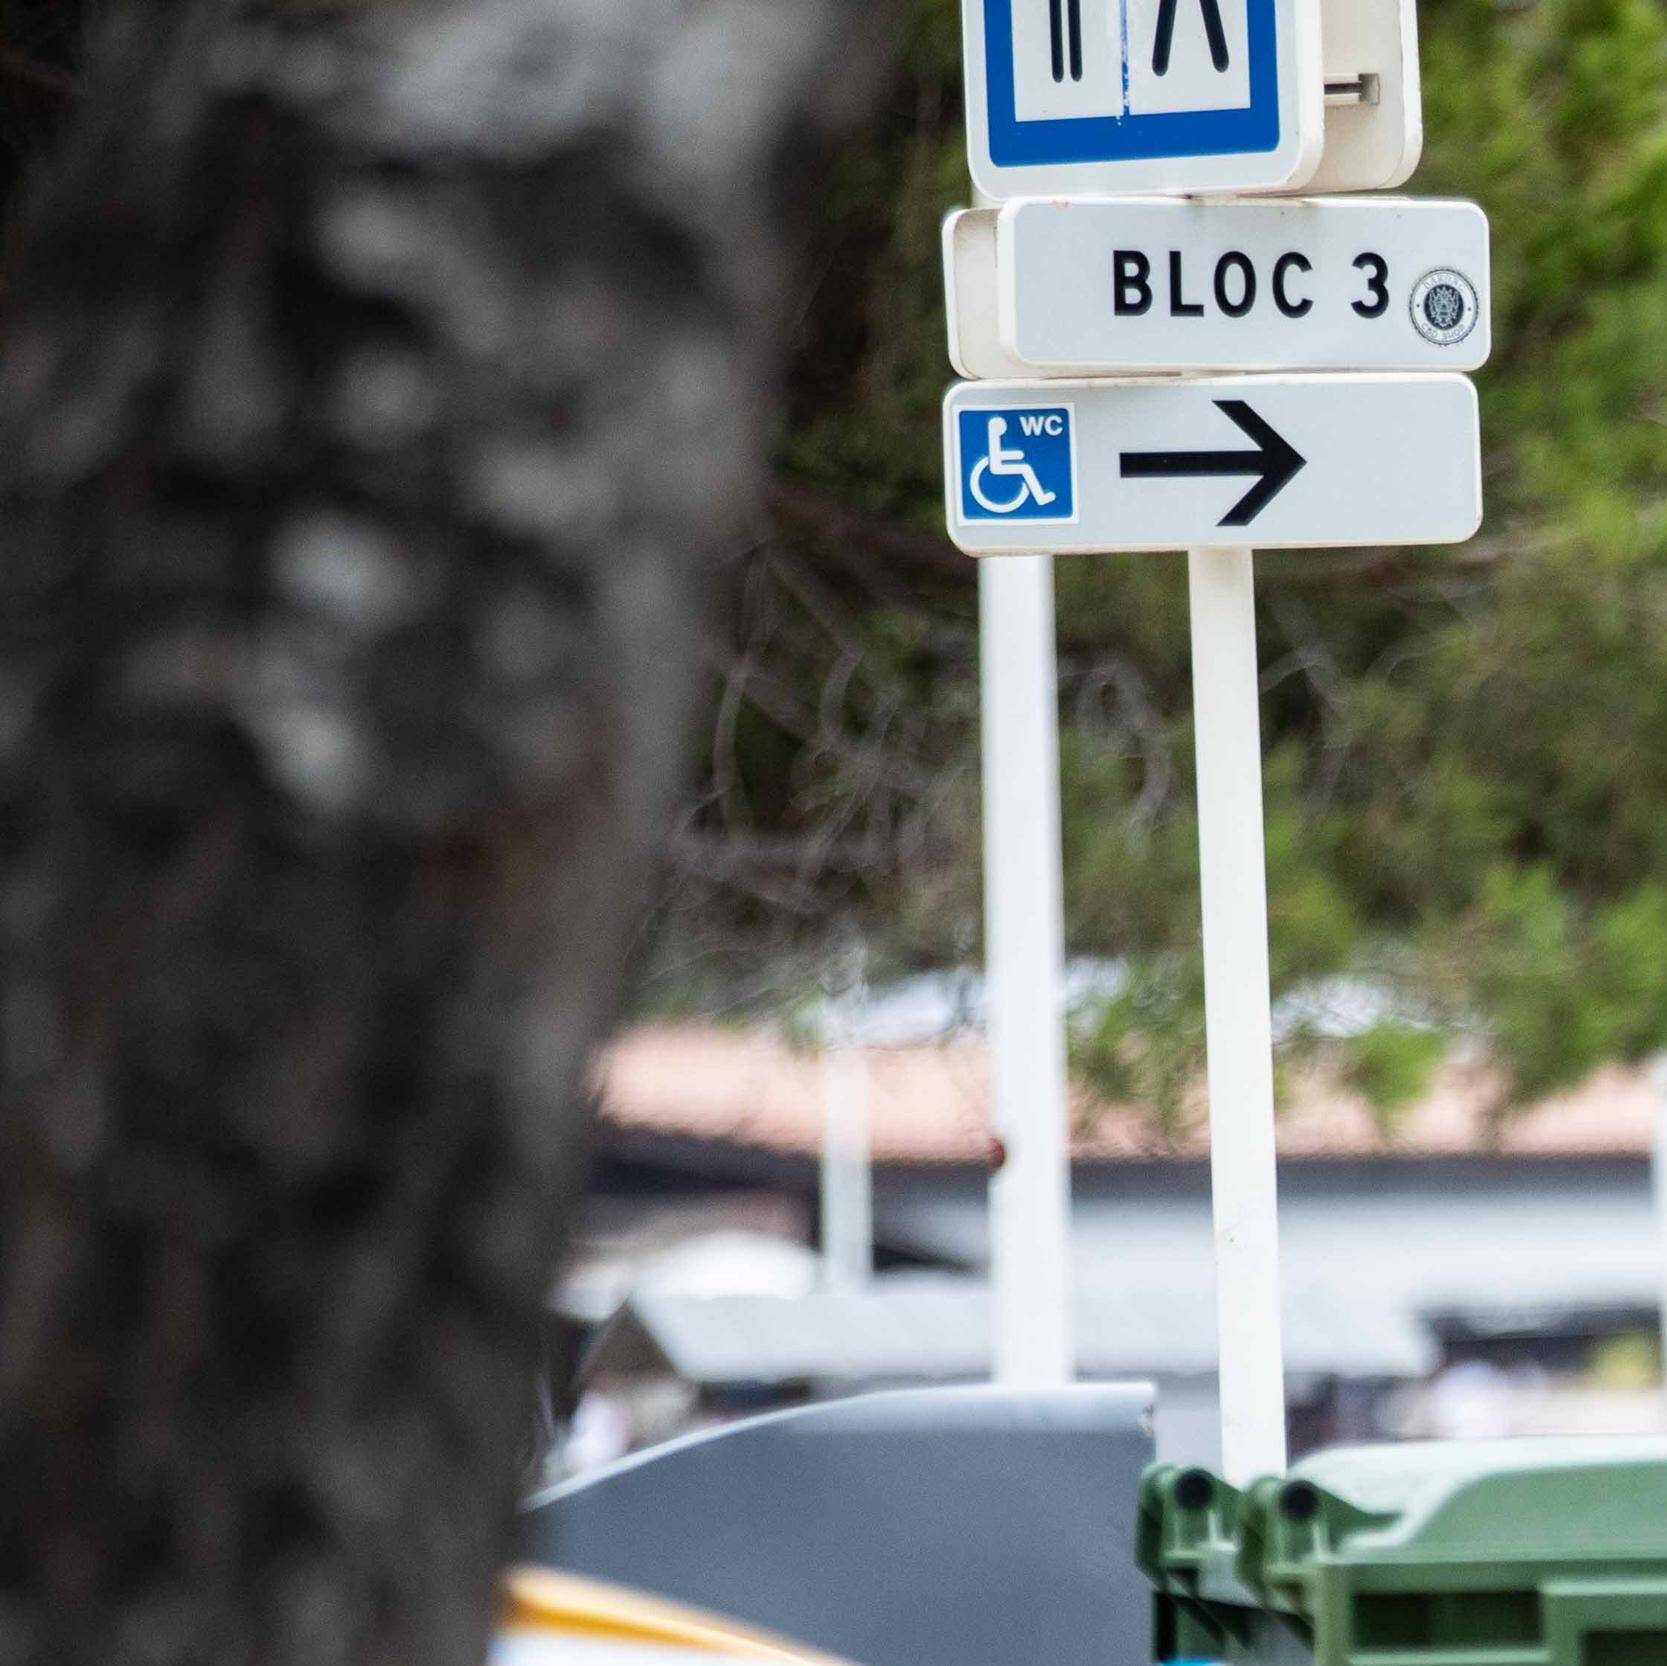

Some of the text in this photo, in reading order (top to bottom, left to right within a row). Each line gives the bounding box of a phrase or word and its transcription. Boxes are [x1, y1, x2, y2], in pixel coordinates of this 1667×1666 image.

[1112, 249, 1390, 319] BLOC 3
[1019, 415, 1064, 437] WC
